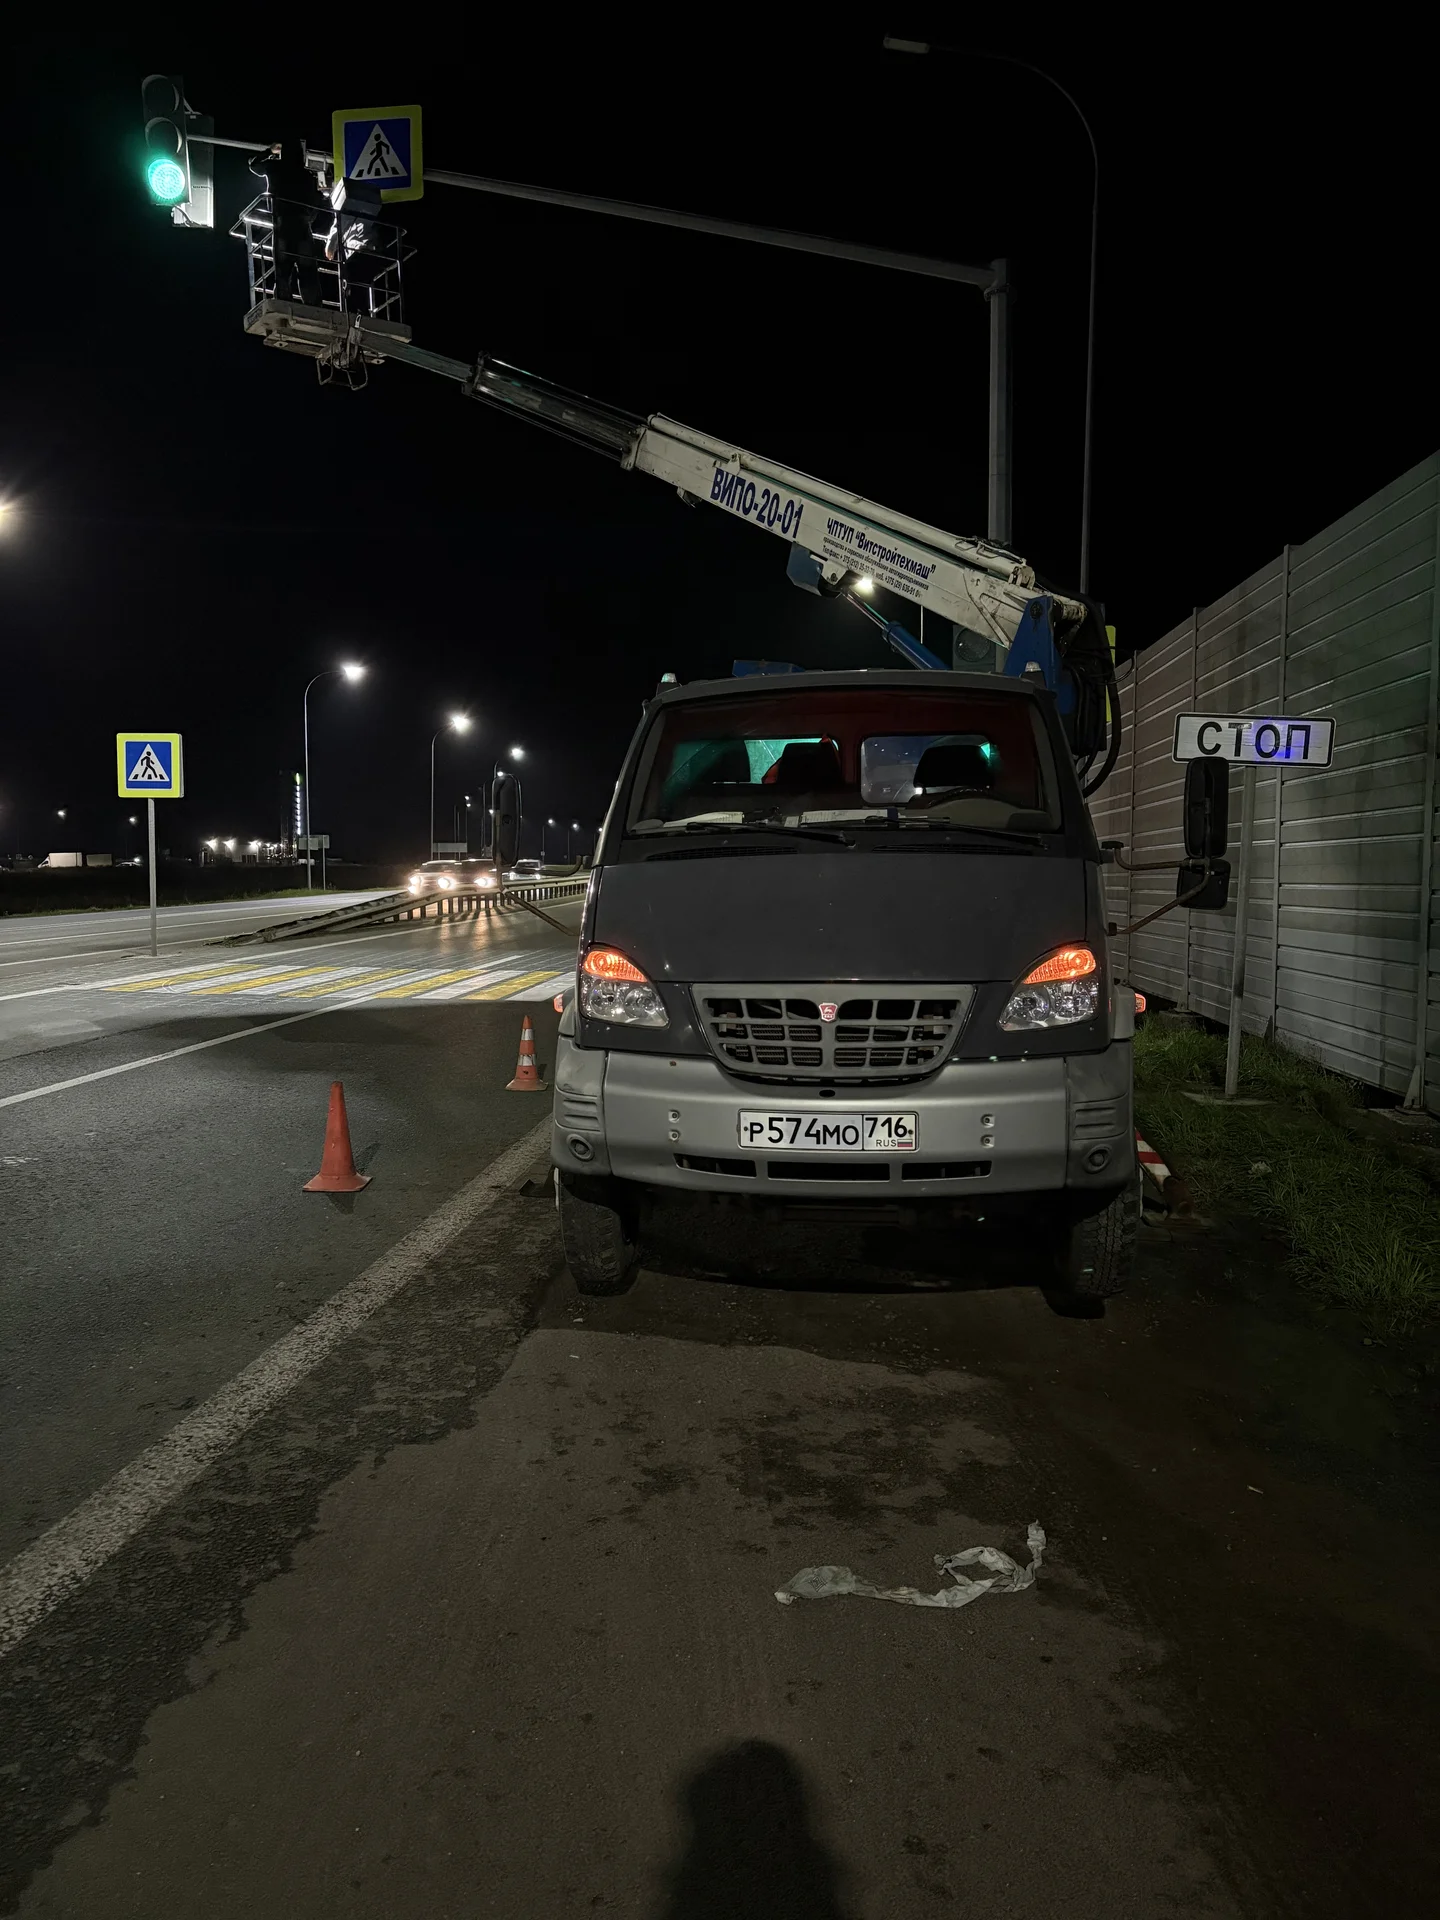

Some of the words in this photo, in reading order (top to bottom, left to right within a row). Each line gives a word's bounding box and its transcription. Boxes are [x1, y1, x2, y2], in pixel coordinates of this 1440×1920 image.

[710, 467, 804, 538] ВИПО-20-01
[827, 517, 854, 544] ЧПТУП
[1197, 721, 1311, 760] СТОП
[865, 1117, 908, 1138] 716
[876, 1139, 897, 1147] RUS
